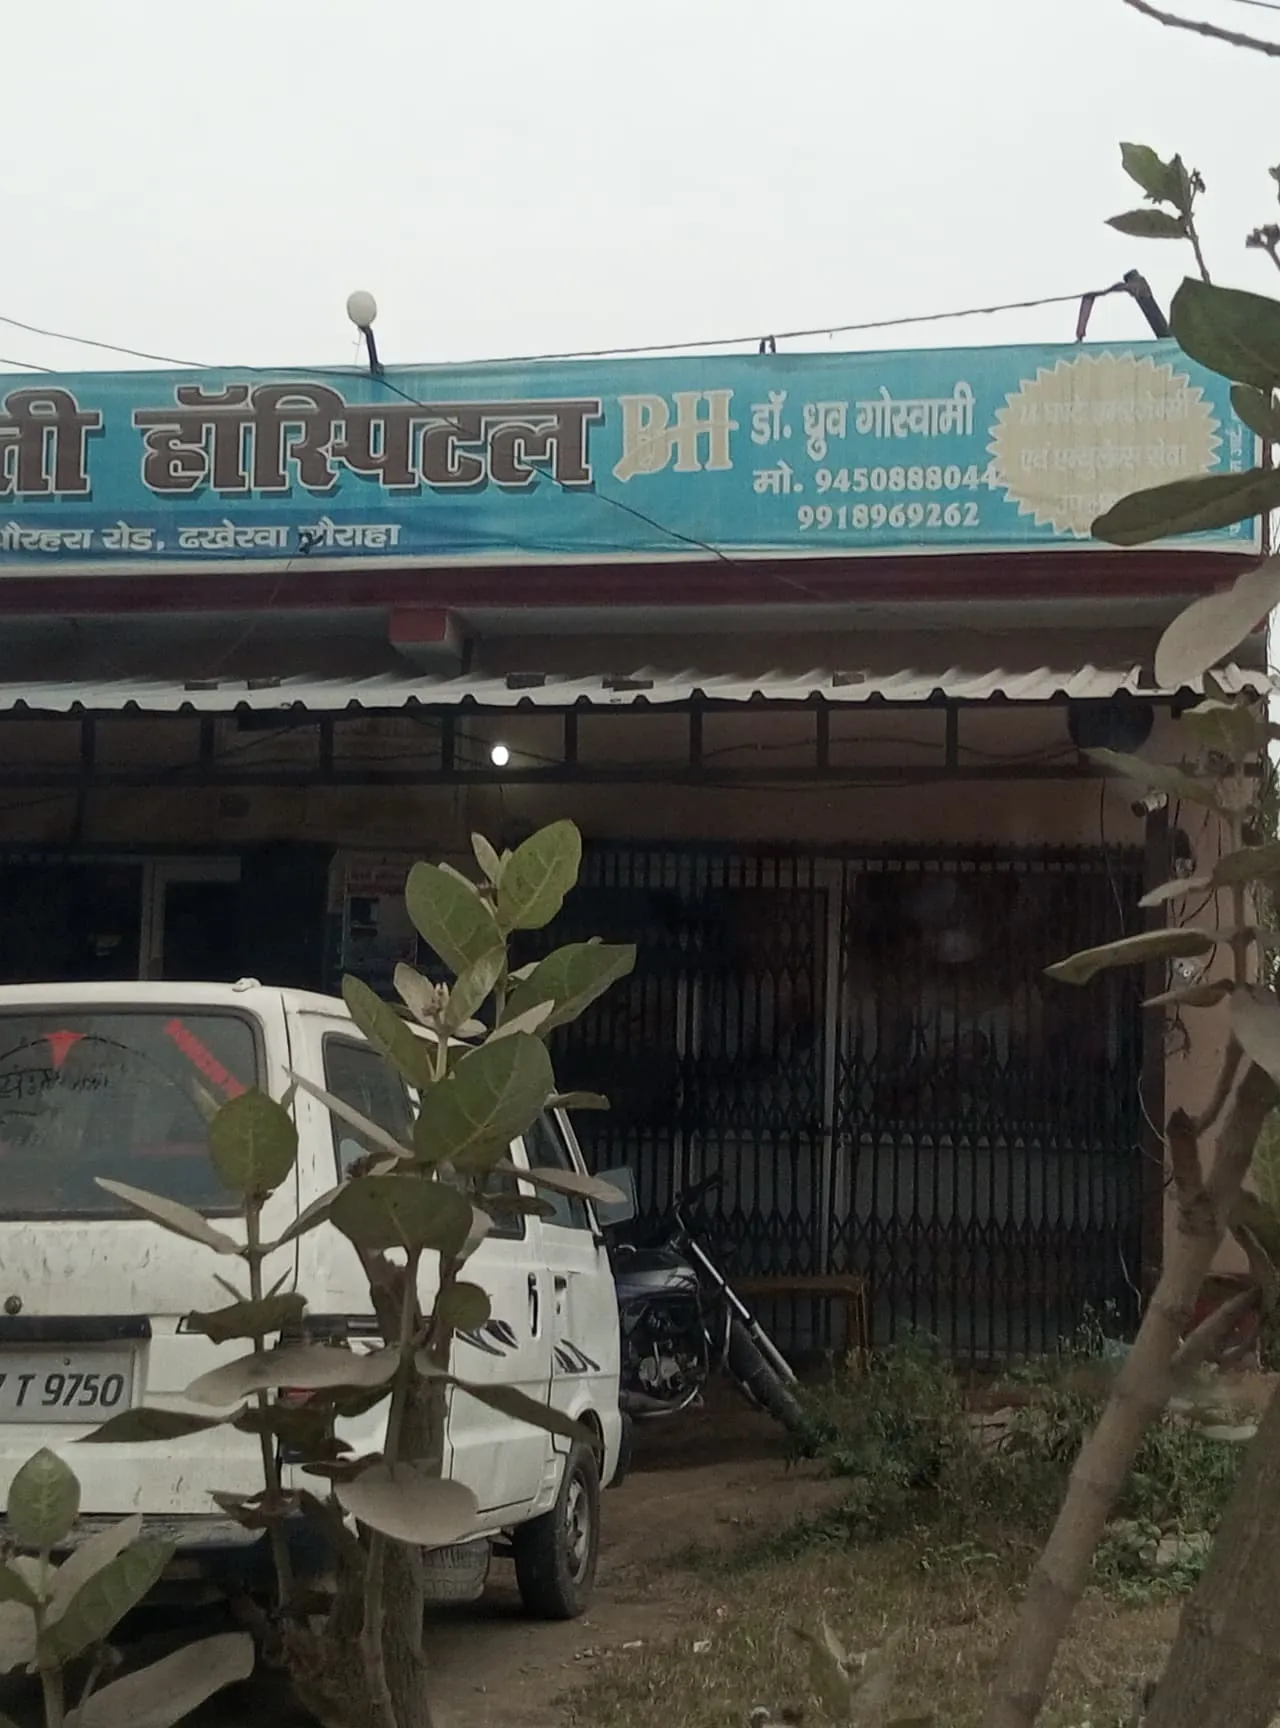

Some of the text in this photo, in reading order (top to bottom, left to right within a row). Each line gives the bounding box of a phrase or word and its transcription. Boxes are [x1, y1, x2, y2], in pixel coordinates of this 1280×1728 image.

[132, 383, 603, 492] हॉस्पिटल
[751, 380, 976, 461] डॉ. ध्रुव गोस्वामी
[753, 459, 1000, 496] मो. 9450888044
[798, 501, 981, 532] 9918969262
[177, 519, 290, 550] ढखेरवा
[16, 1373, 36, 1407] T
[41, 1373, 125, 1407] 9750
